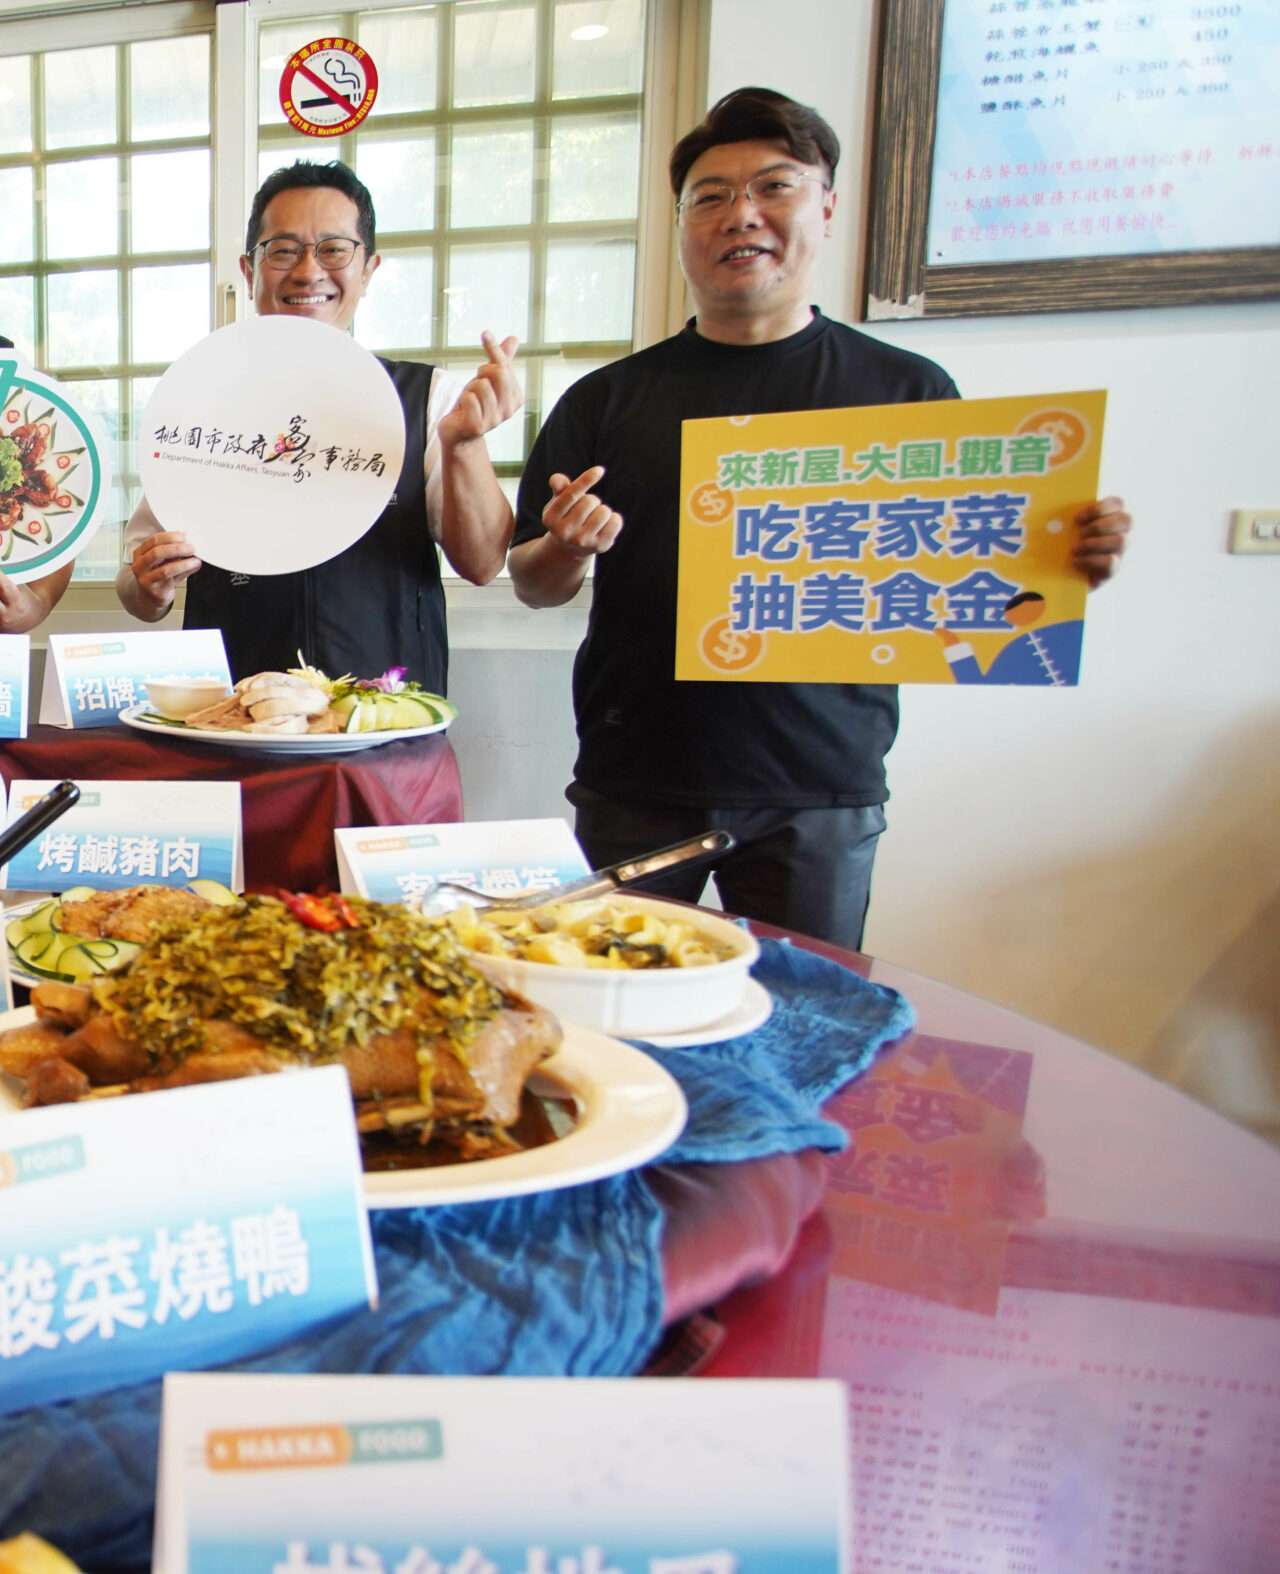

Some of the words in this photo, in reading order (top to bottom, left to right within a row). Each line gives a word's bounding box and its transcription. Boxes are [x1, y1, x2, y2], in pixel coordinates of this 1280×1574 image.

[161, 452, 204, 465] Department
[732, 492, 1029, 564] 吃客家菜
[730, 568, 1023, 633] 抽美食金
[37, 833, 201, 879] 烤鹹豬肉
